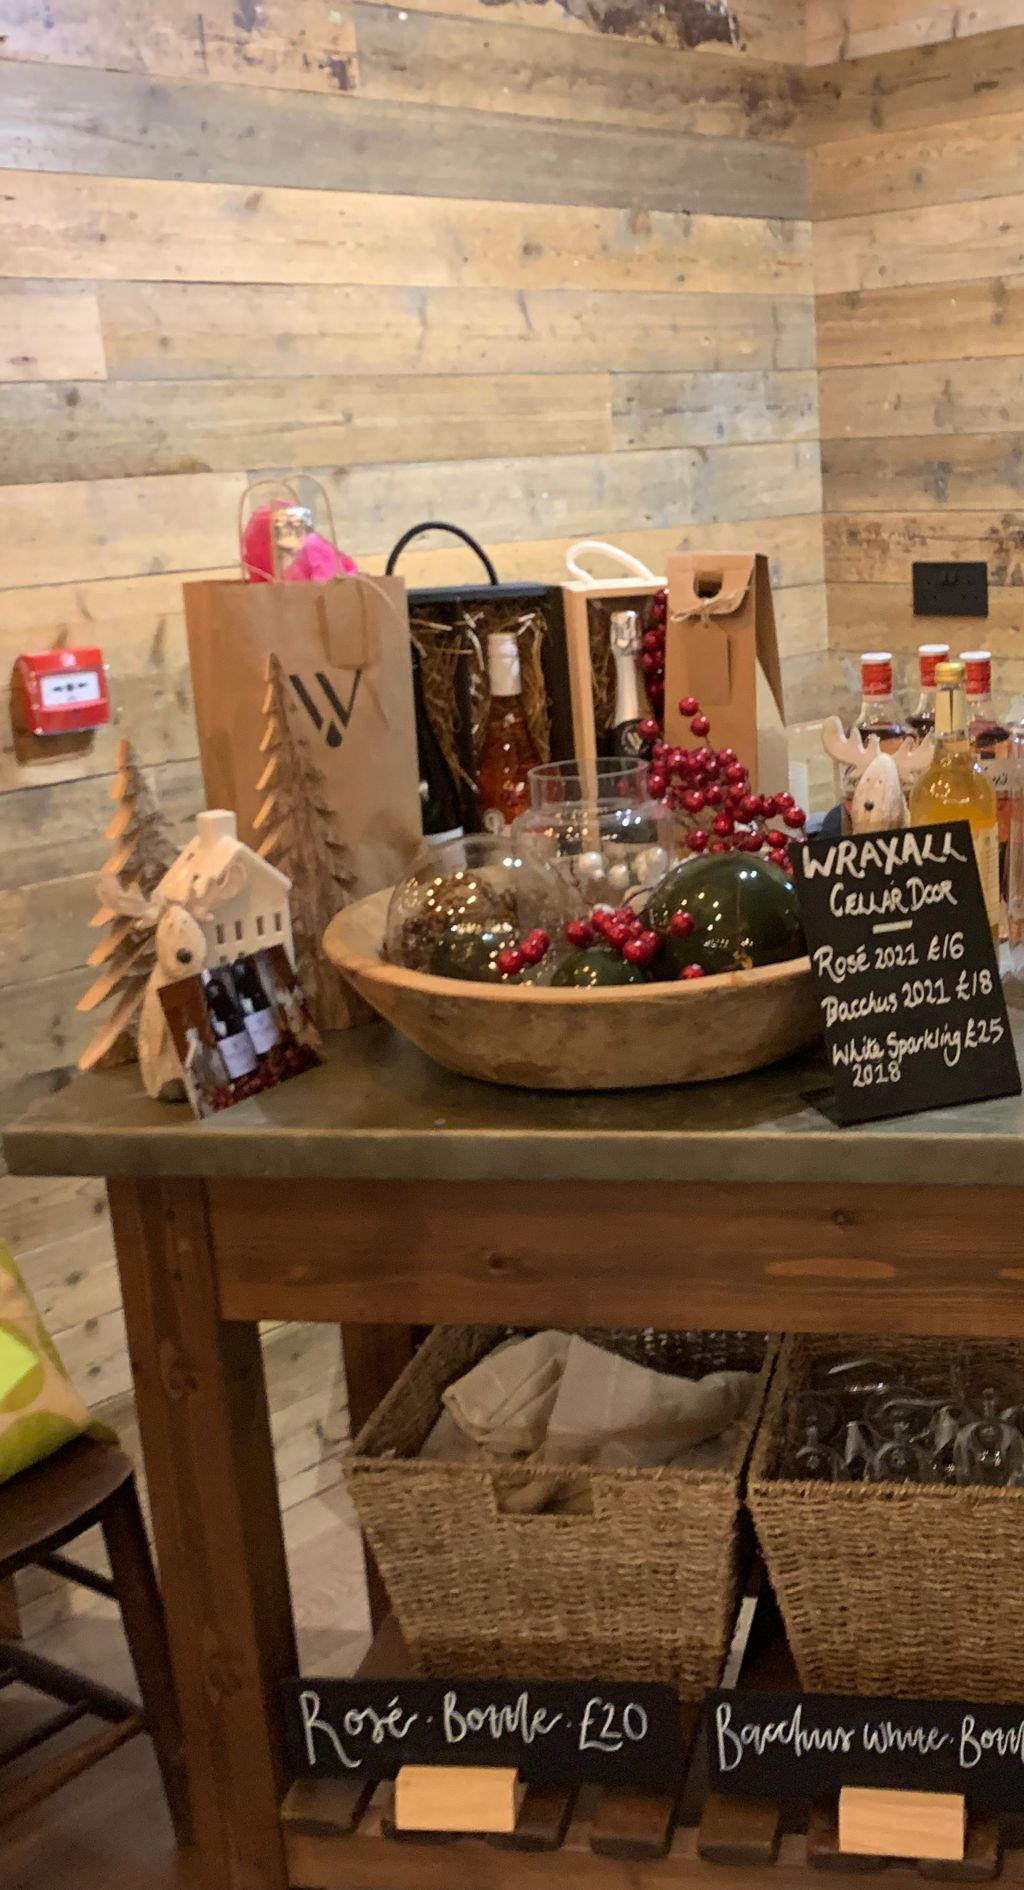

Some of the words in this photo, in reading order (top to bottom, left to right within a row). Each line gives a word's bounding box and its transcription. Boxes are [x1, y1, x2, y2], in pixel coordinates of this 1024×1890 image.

[802, 832, 968, 879] WRAXALL
[829, 880, 910, 917] CELLAR
[813, 945, 871, 984] Rosé
[873, 942, 919, 970] 2021
[926, 931, 965, 962] £16
[821, 990, 898, 1028] Bacchus
[901, 977, 952, 1009] 2021
[955, 968, 993, 1001] £18
[832, 1034, 886, 1067] White
[886, 1023, 962, 1068] Sparkling
[964, 1017, 1004, 1049] £25
[852, 1060, 902, 1089] 2018
[299, 1690, 419, 1769] Rosé
[443, 1690, 563, 1744] Bottle
[578, 1697, 649, 1753] £20
[716, 1702, 856, 1772] Bacchus
[862, 1720, 950, 1756] White
